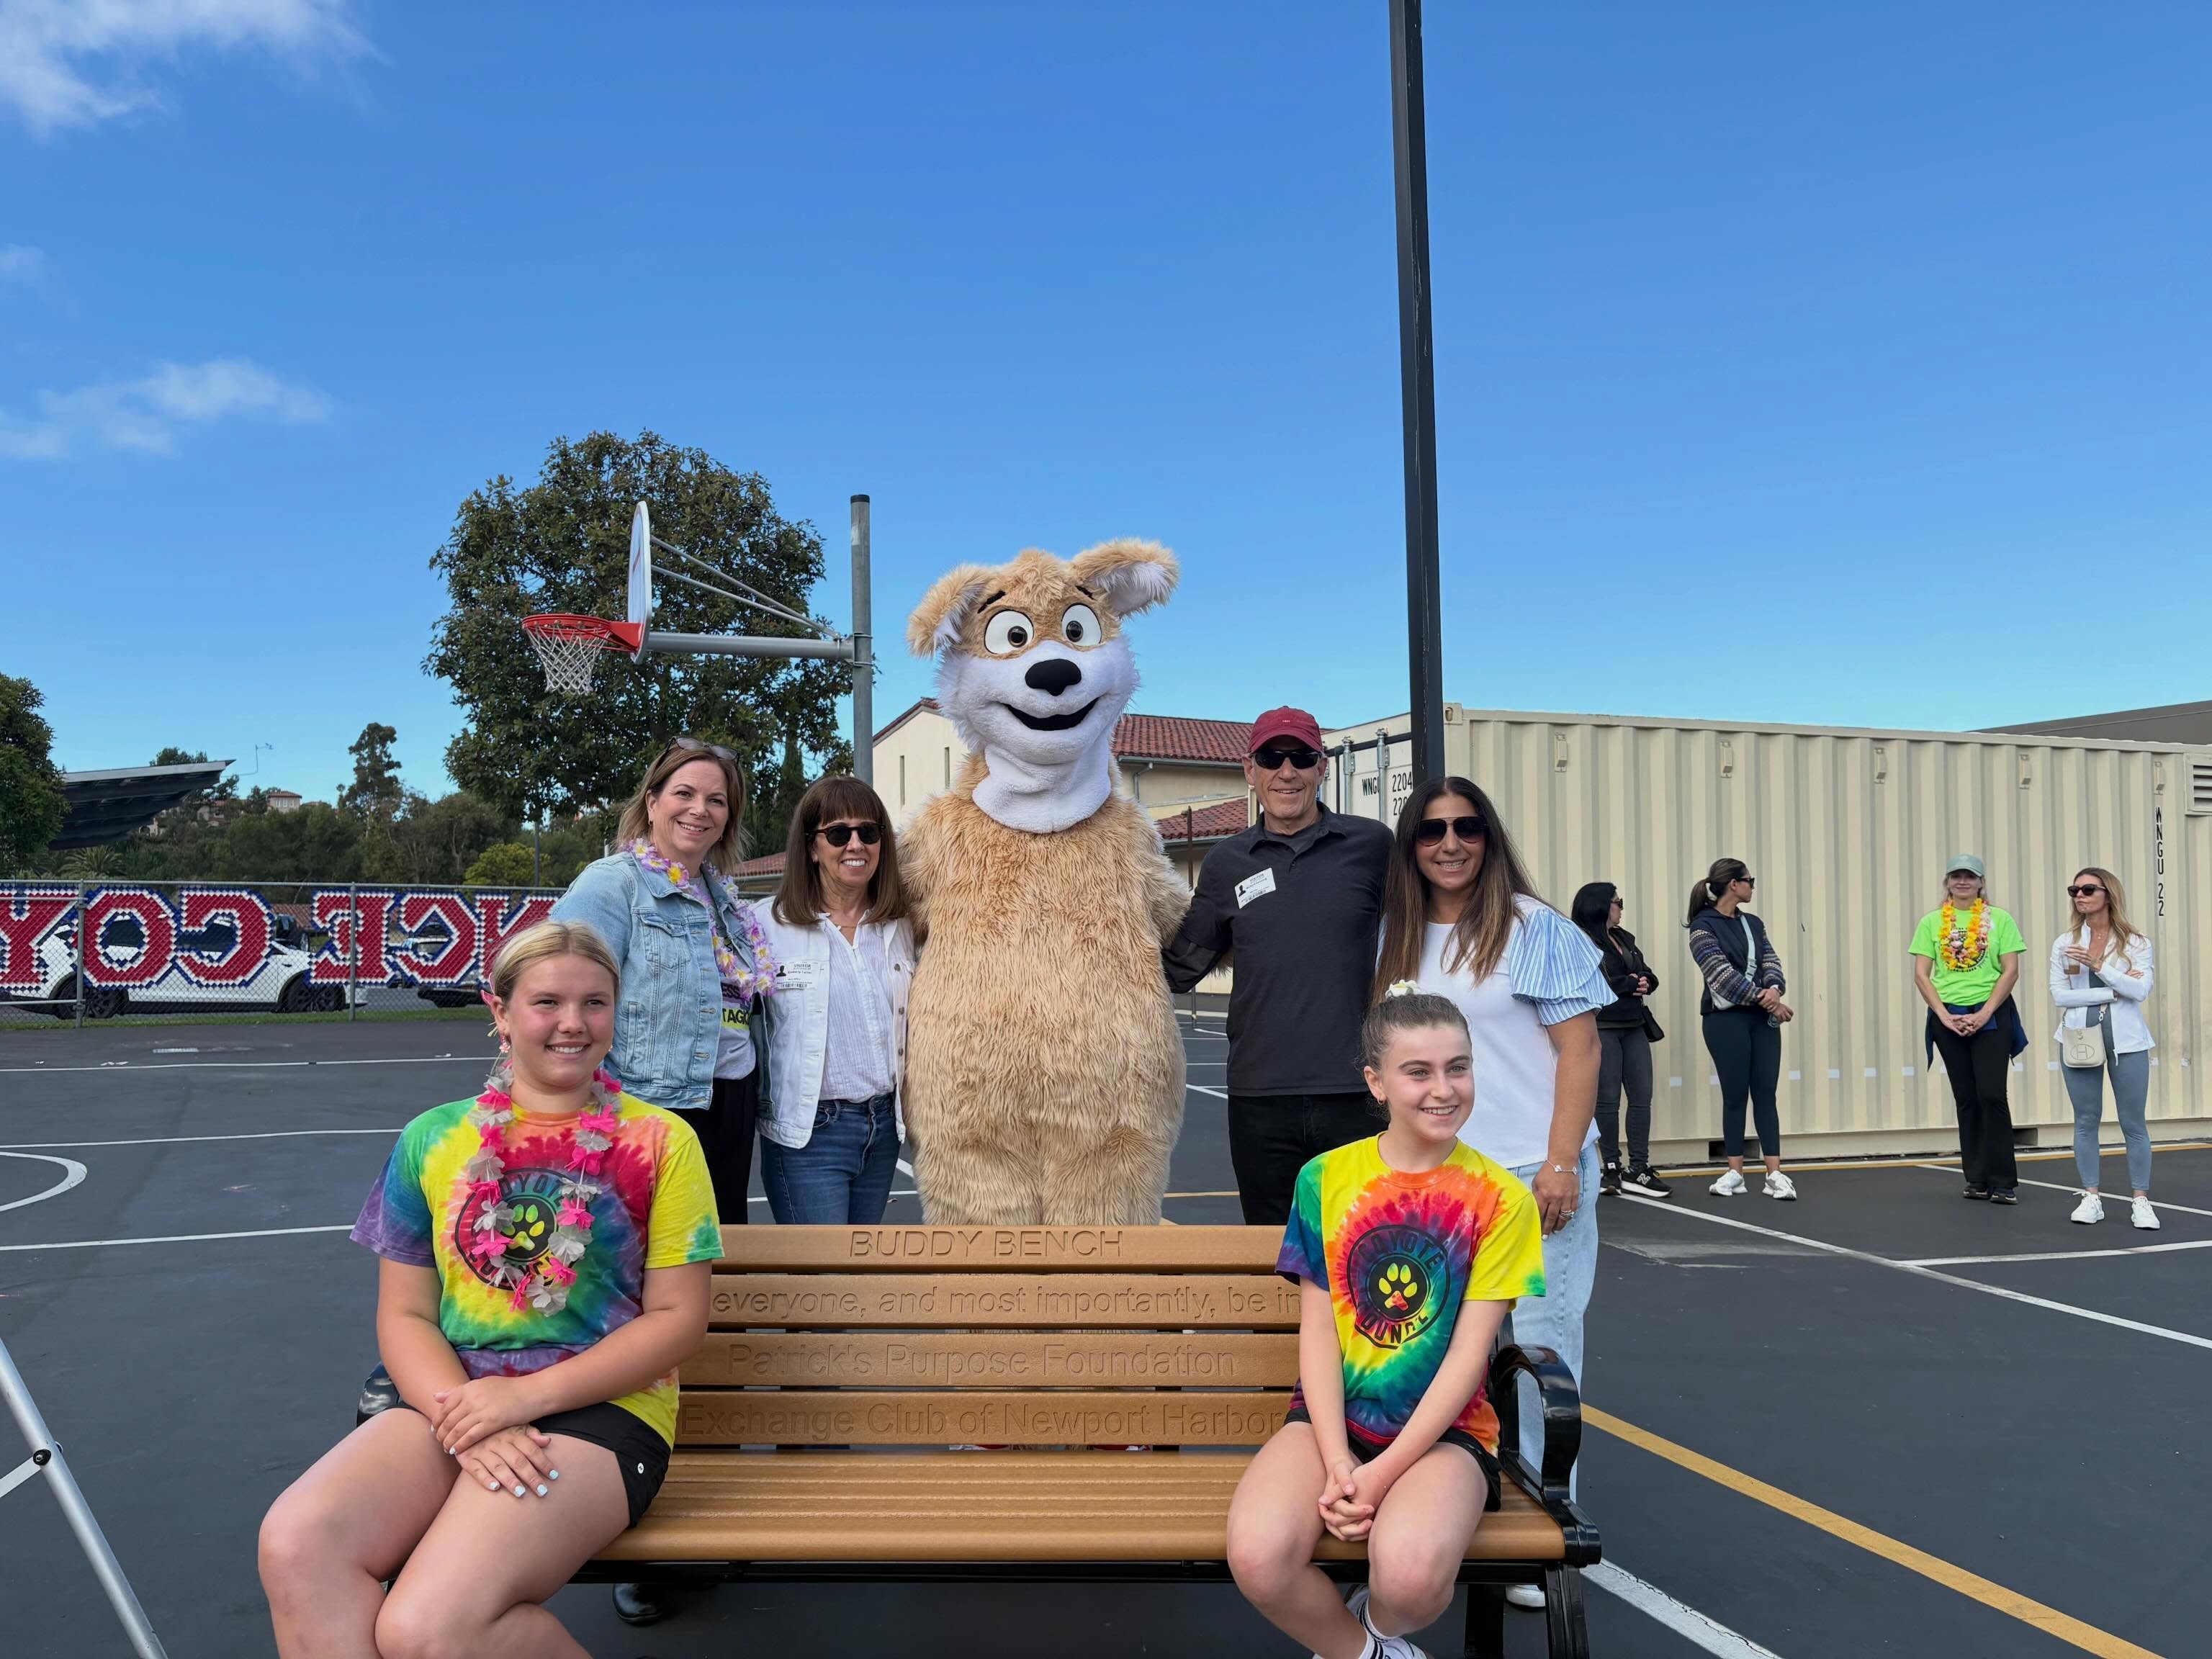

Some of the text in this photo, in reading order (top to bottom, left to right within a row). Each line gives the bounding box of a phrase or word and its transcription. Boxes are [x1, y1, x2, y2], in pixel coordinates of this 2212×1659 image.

[1362, 771, 1412, 796] WNG 2204
[849, 1230, 1124, 1257] BUDDY BENCH
[1357, 1230, 1444, 1271] COYOTE
[712, 1292, 867, 1319] everyone,
[878, 1285, 938, 1314] and
[949, 1287, 1027, 1314] most
[1035, 1285, 1216, 1320] importantly,
[1227, 1285, 1267, 1313] be
[726, 1343, 1236, 1384] Patrick's Purpose Foundation
[680, 1403, 1284, 1442] Exchange Club of Newport Harbor
